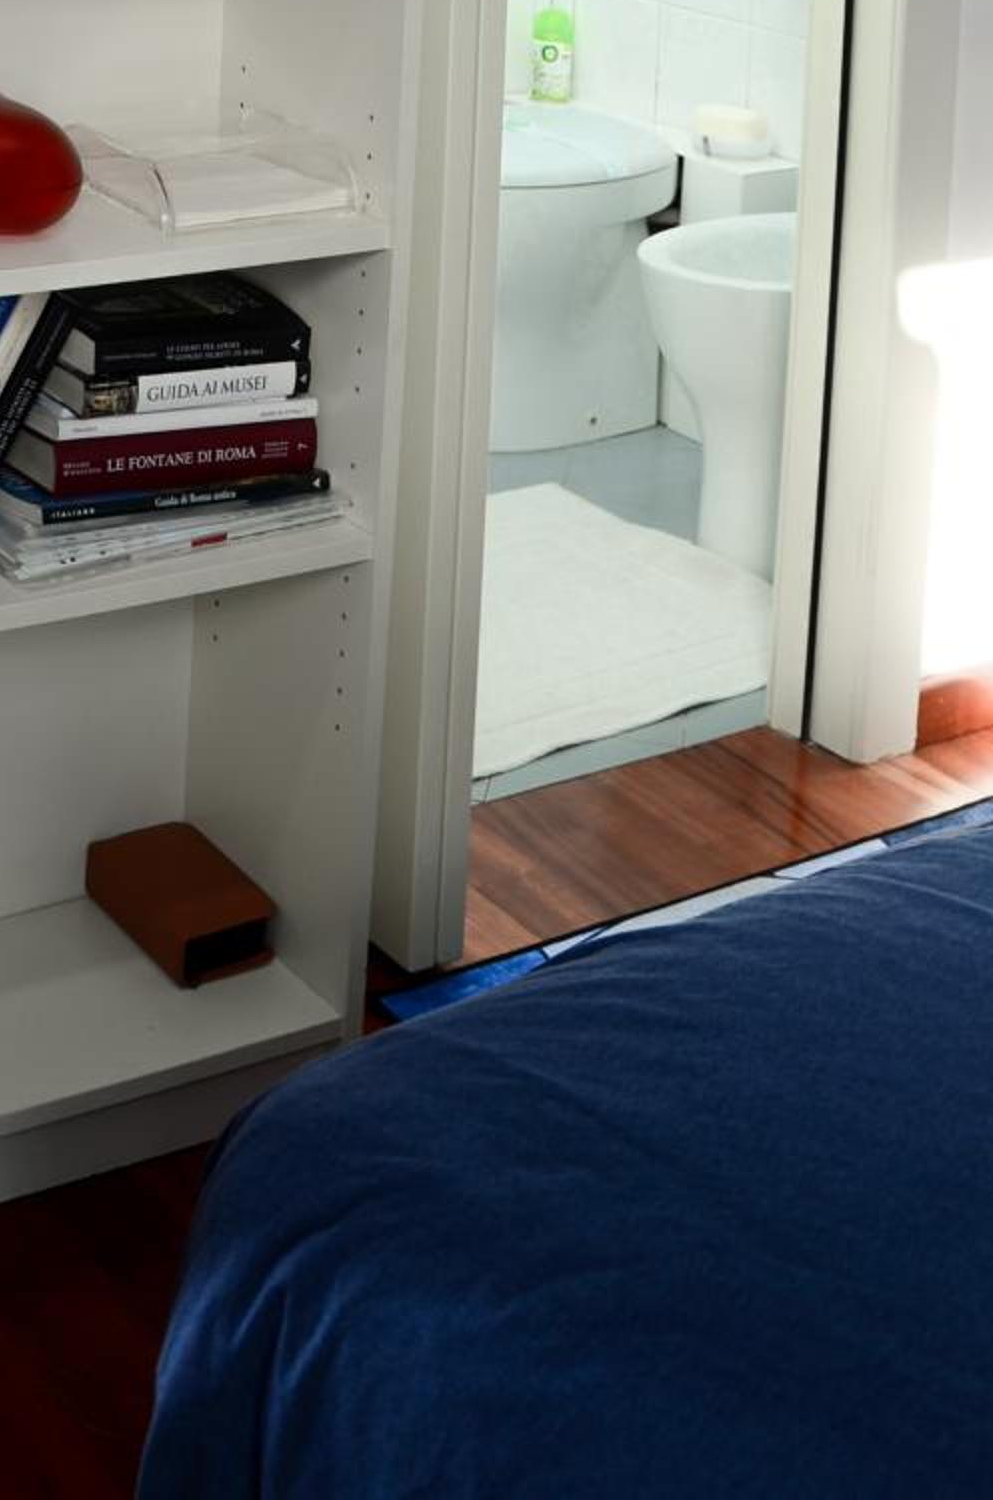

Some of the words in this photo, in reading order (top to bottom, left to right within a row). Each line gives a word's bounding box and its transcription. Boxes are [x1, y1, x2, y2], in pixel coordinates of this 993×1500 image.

[146, 382, 199, 402] GUIDA
[201, 380, 217, 398] AI
[220, 375, 269, 394] MUSEI
[107, 455, 125, 472] LE
[128, 451, 194, 471] FONTANE
[196, 449, 213, 463] DI
[215, 446, 257, 462] ROMA
